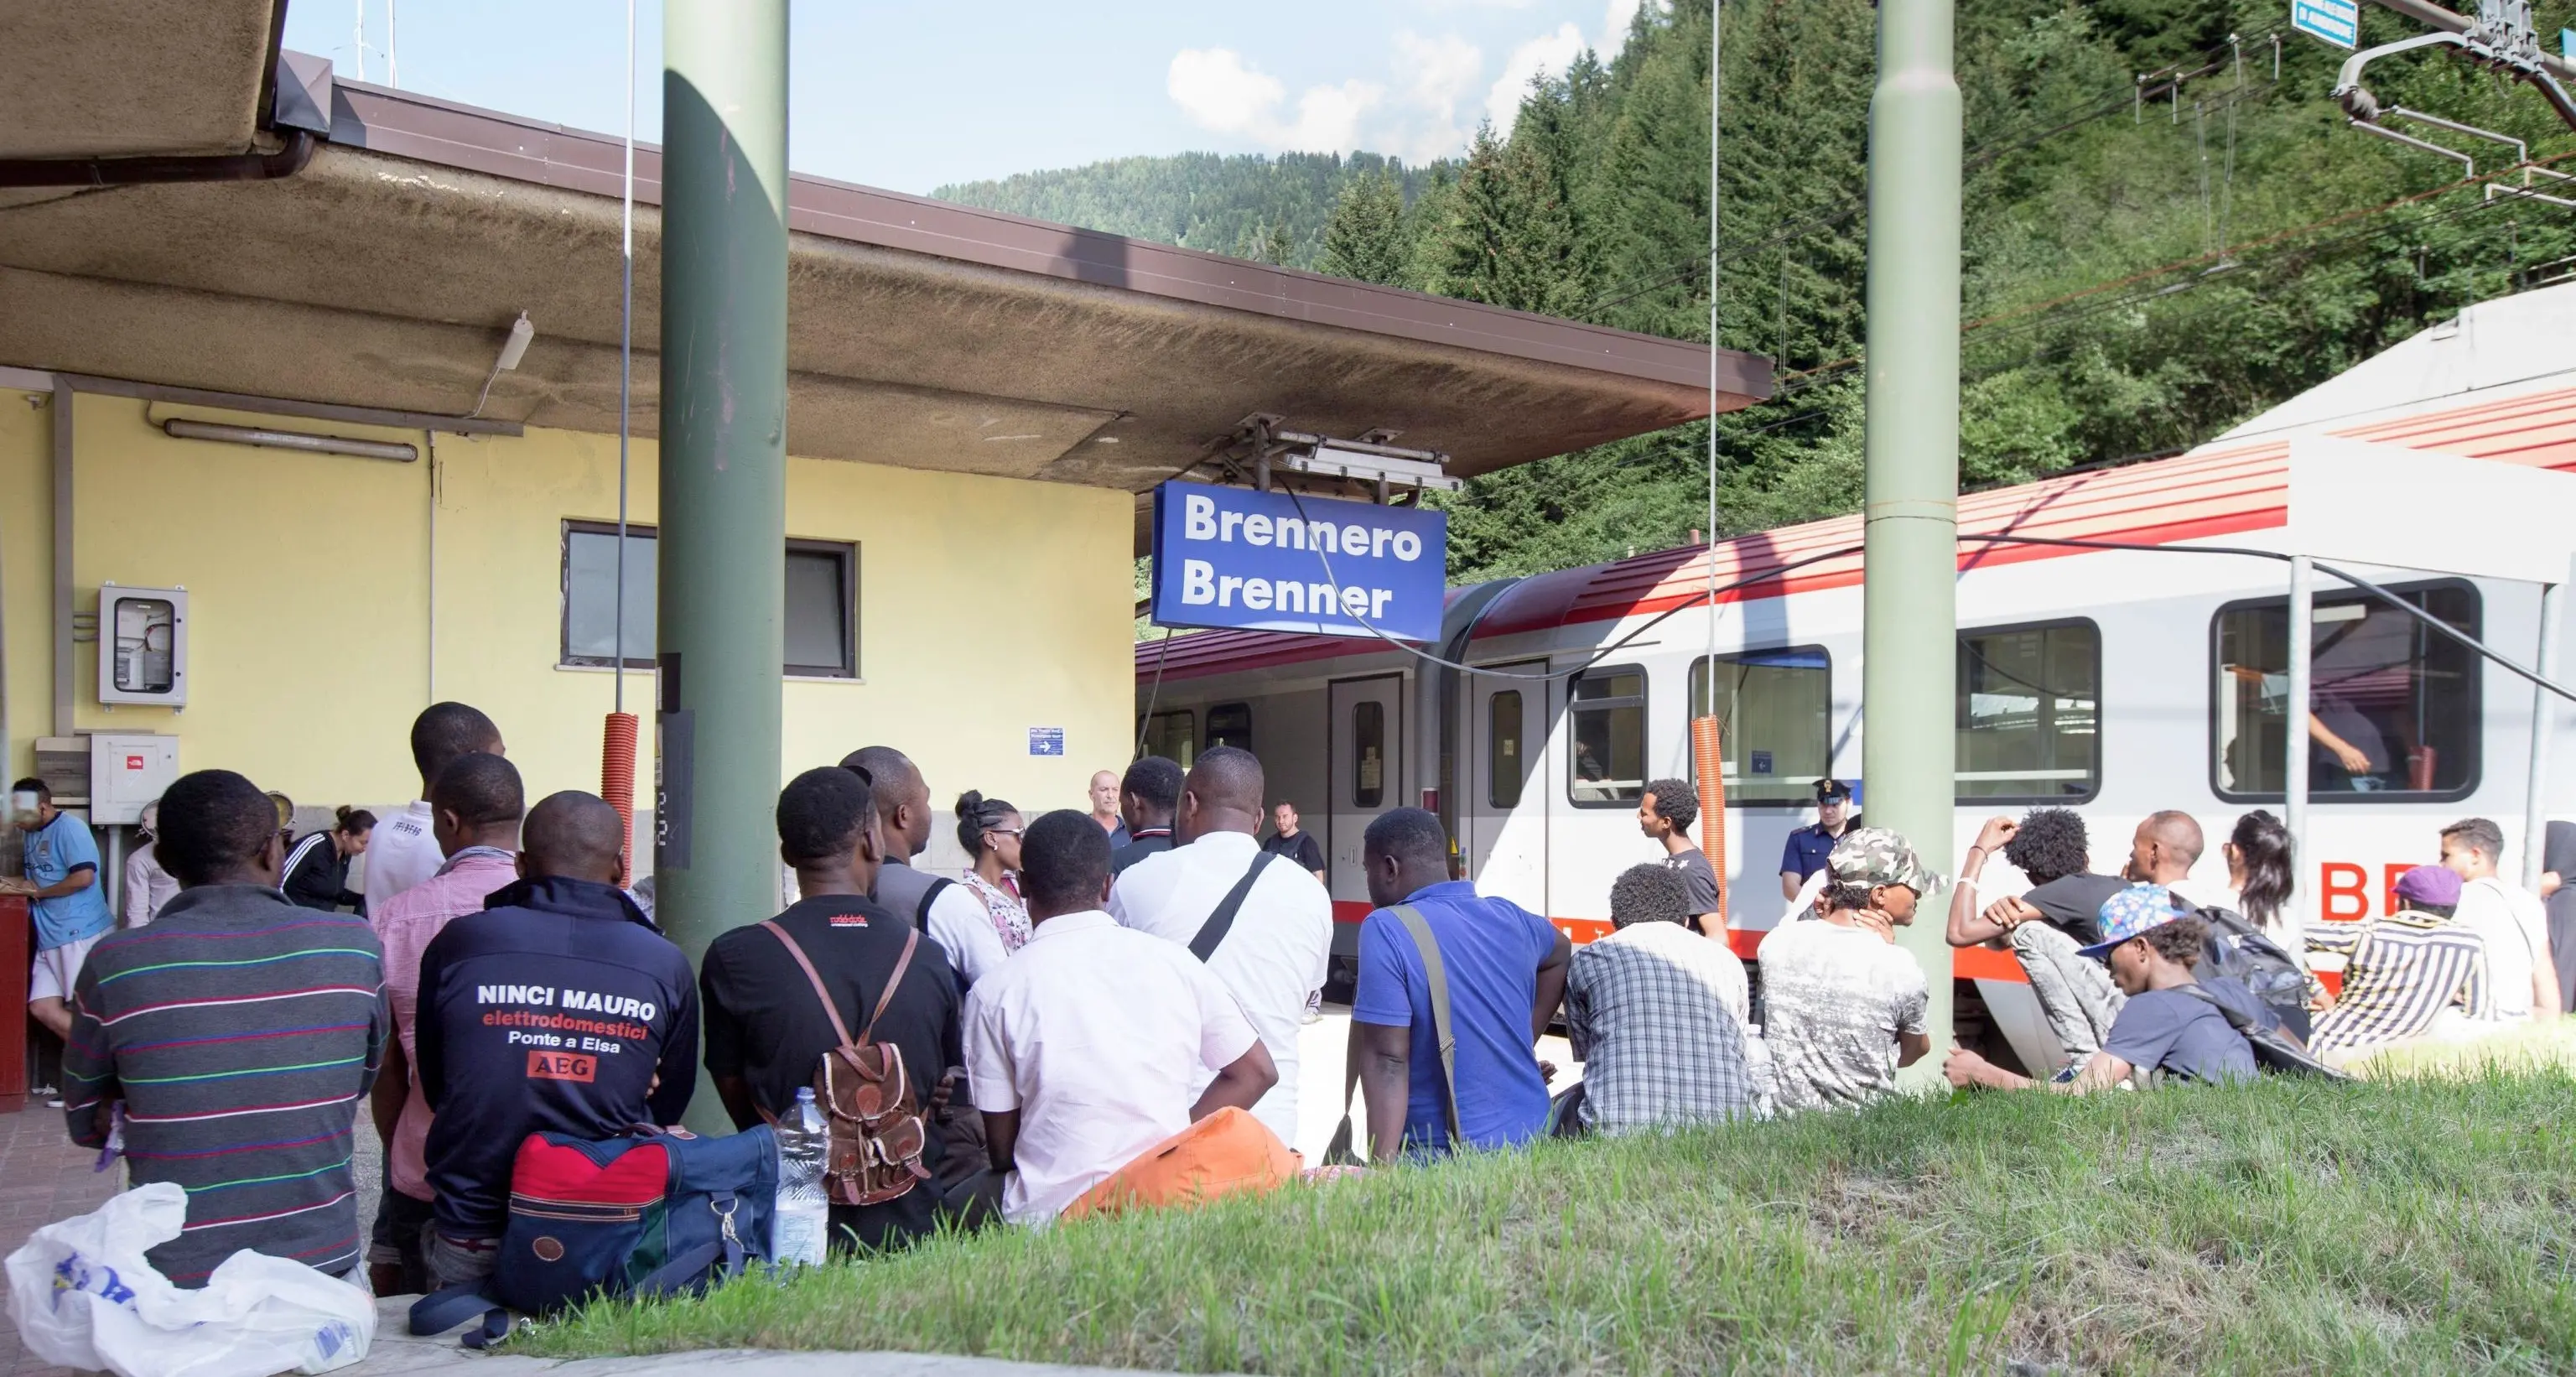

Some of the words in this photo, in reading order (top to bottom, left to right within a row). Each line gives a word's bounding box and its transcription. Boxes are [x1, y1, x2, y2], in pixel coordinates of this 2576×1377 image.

[1185, 494, 1422, 562] Brennero
[1182, 559, 1393, 619] Brenner
[477, 985, 555, 1006] NINCI
[562, 990, 656, 1021] MAURO
[482, 1010, 648, 1041] elettrodomestici
[508, 1031, 561, 1047] Ponte
[565, 1037, 577, 1048] a
[582, 1037, 621, 1054] Elsa
[535, 1056, 589, 1077] AEG
